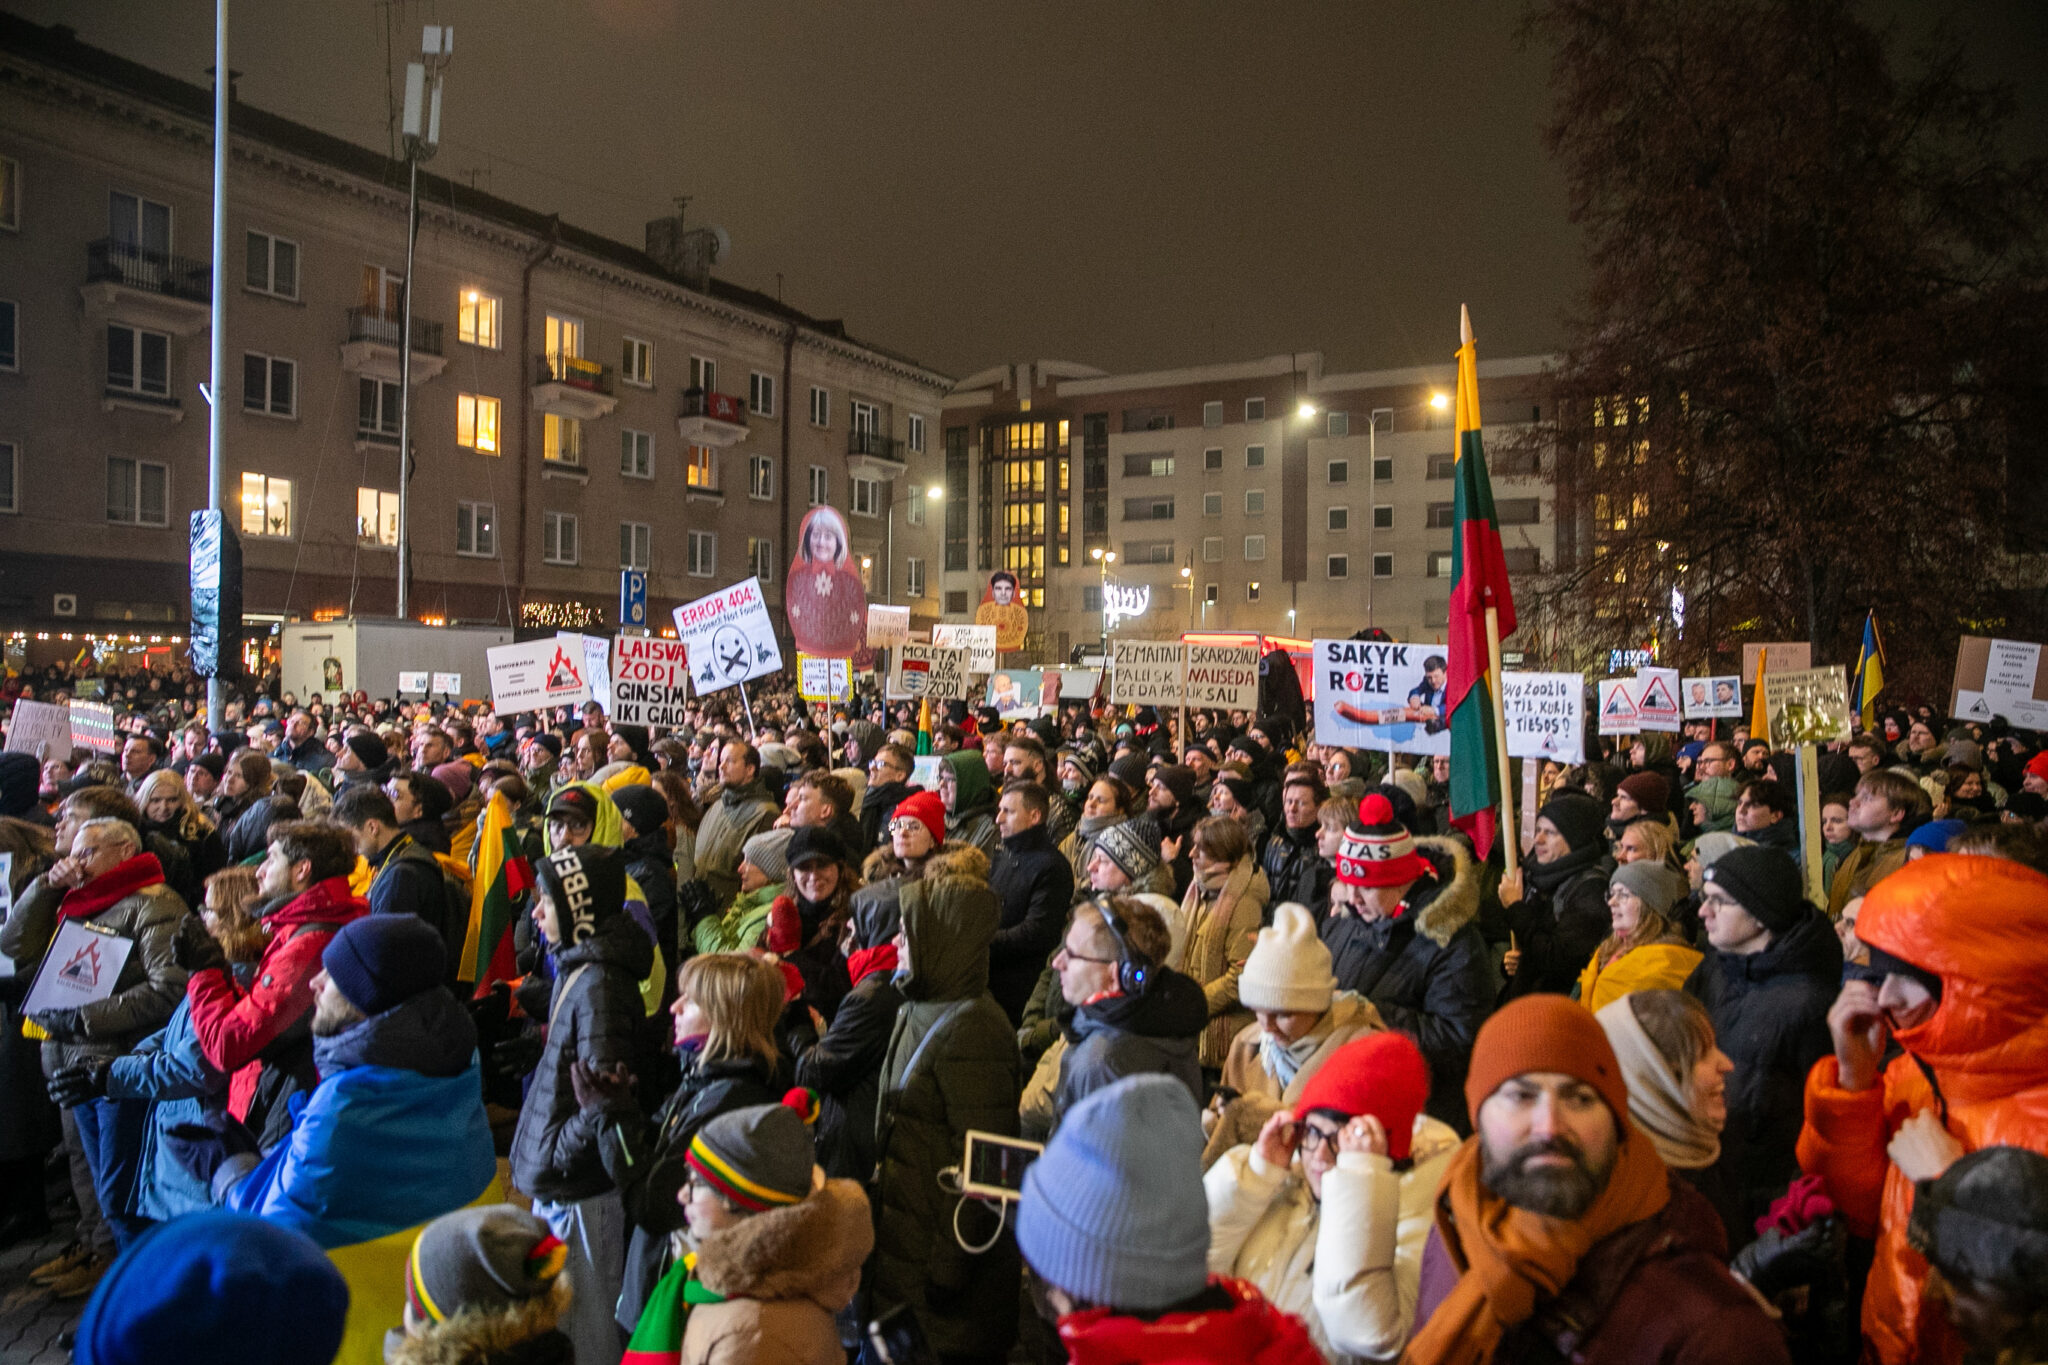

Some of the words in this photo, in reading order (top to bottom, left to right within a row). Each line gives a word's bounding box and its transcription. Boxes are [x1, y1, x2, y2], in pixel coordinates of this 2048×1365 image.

[681, 598, 727, 628] ERROR
[729, 586, 756, 608] 404:
[681, 627, 697, 639] Free
[698, 617, 721, 635] Speech
[723, 611, 737, 624] Not
[739, 600, 763, 616] Found
[618, 639, 688, 670] LAISVĄ
[1327, 642, 1408, 667] SAKYK
[1329, 667, 1390, 693] ROŽĖ
[1502, 682, 1522, 698] SVO
[1524, 680, 1567, 697] ŽODŽIO
[616, 682, 685, 705] GINSIM
[1205, 687, 1238, 703] SAU
[617, 704, 640, 721] IKI
[647, 706, 685, 726] GALO
[1539, 699, 1574, 716] KURIE
[1342, 841, 1392, 860] TAS
